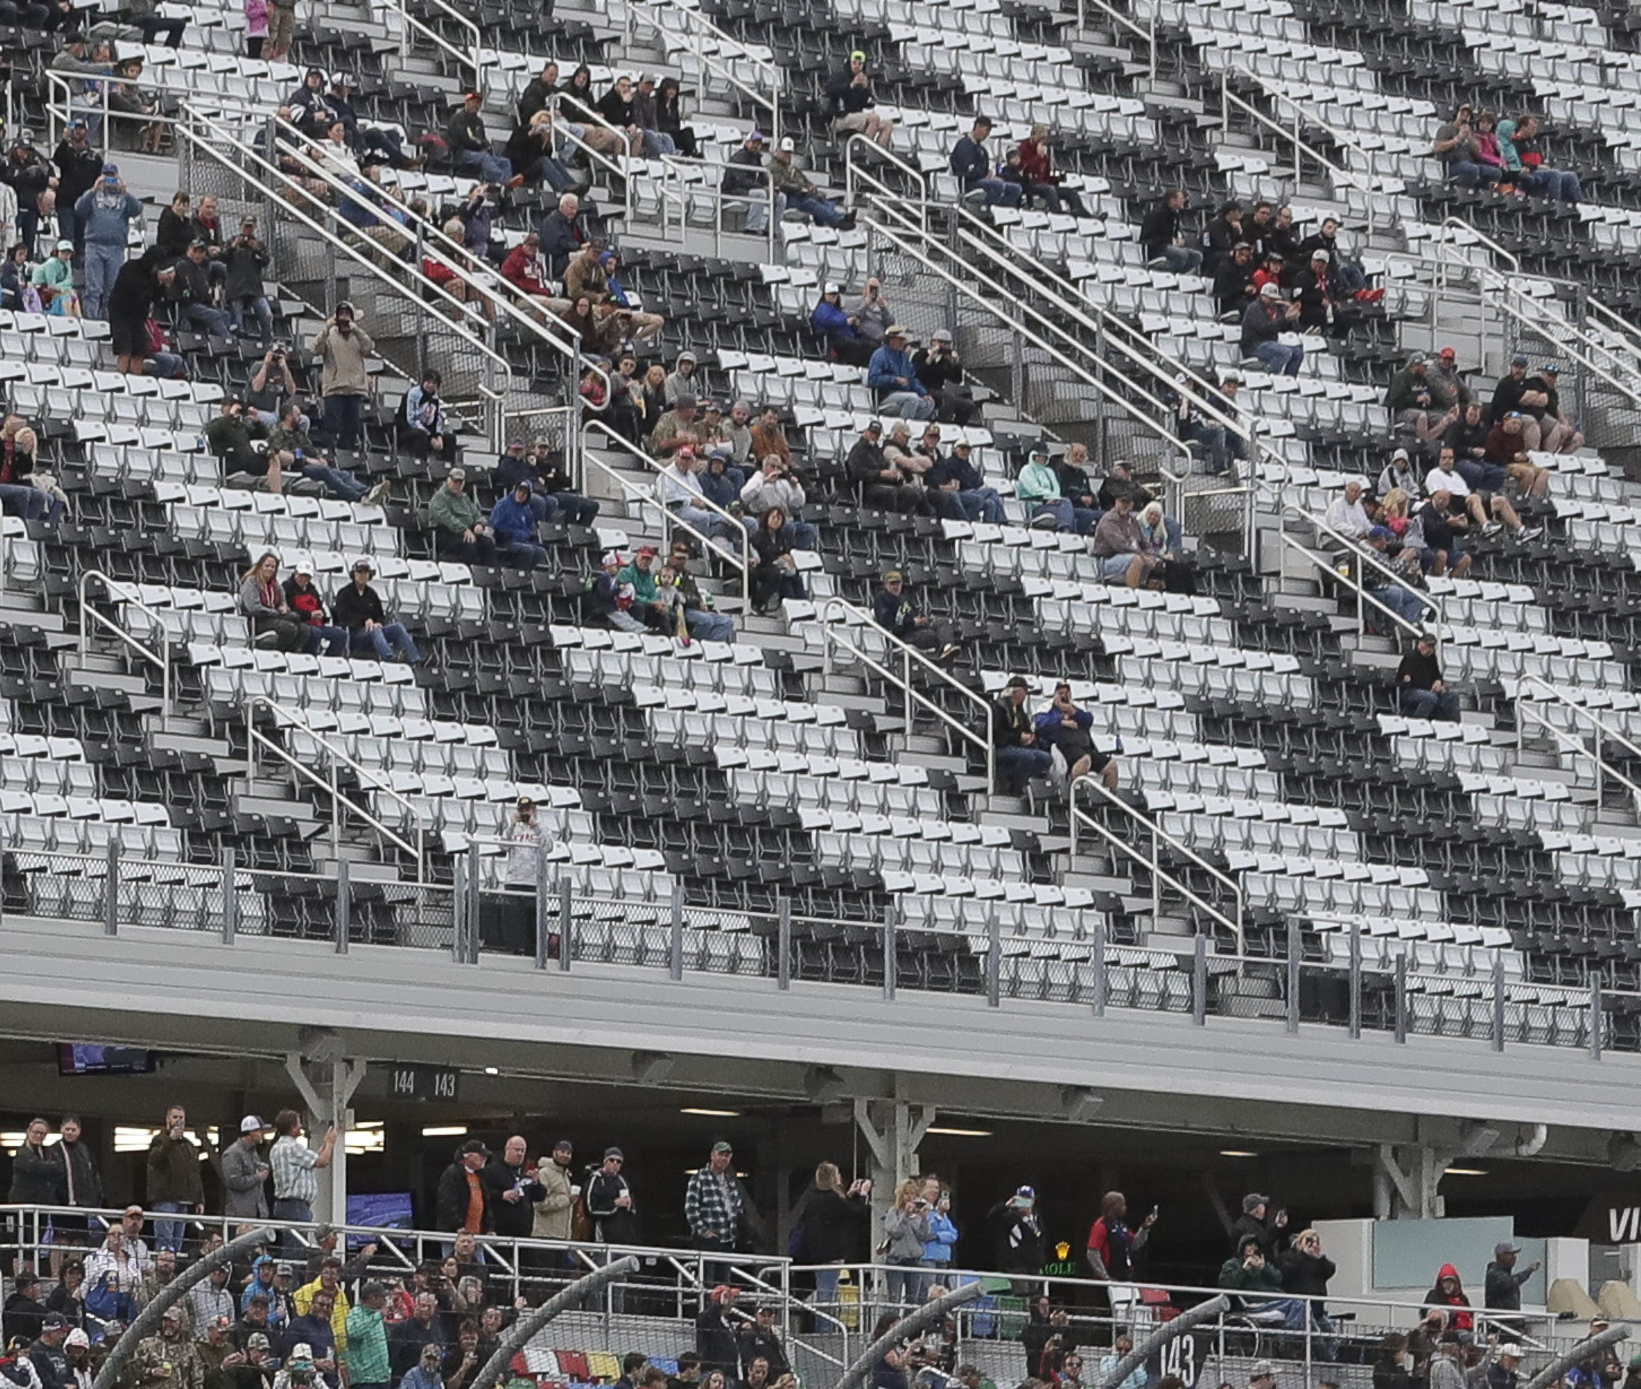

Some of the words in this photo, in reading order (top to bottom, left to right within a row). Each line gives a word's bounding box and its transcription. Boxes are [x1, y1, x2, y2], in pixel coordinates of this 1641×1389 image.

[394, 1070, 415, 1094] 144
[435, 1073, 456, 1096] 143
[1609, 1206, 1641, 1241] VI
[1160, 1334, 1195, 1387] 143
